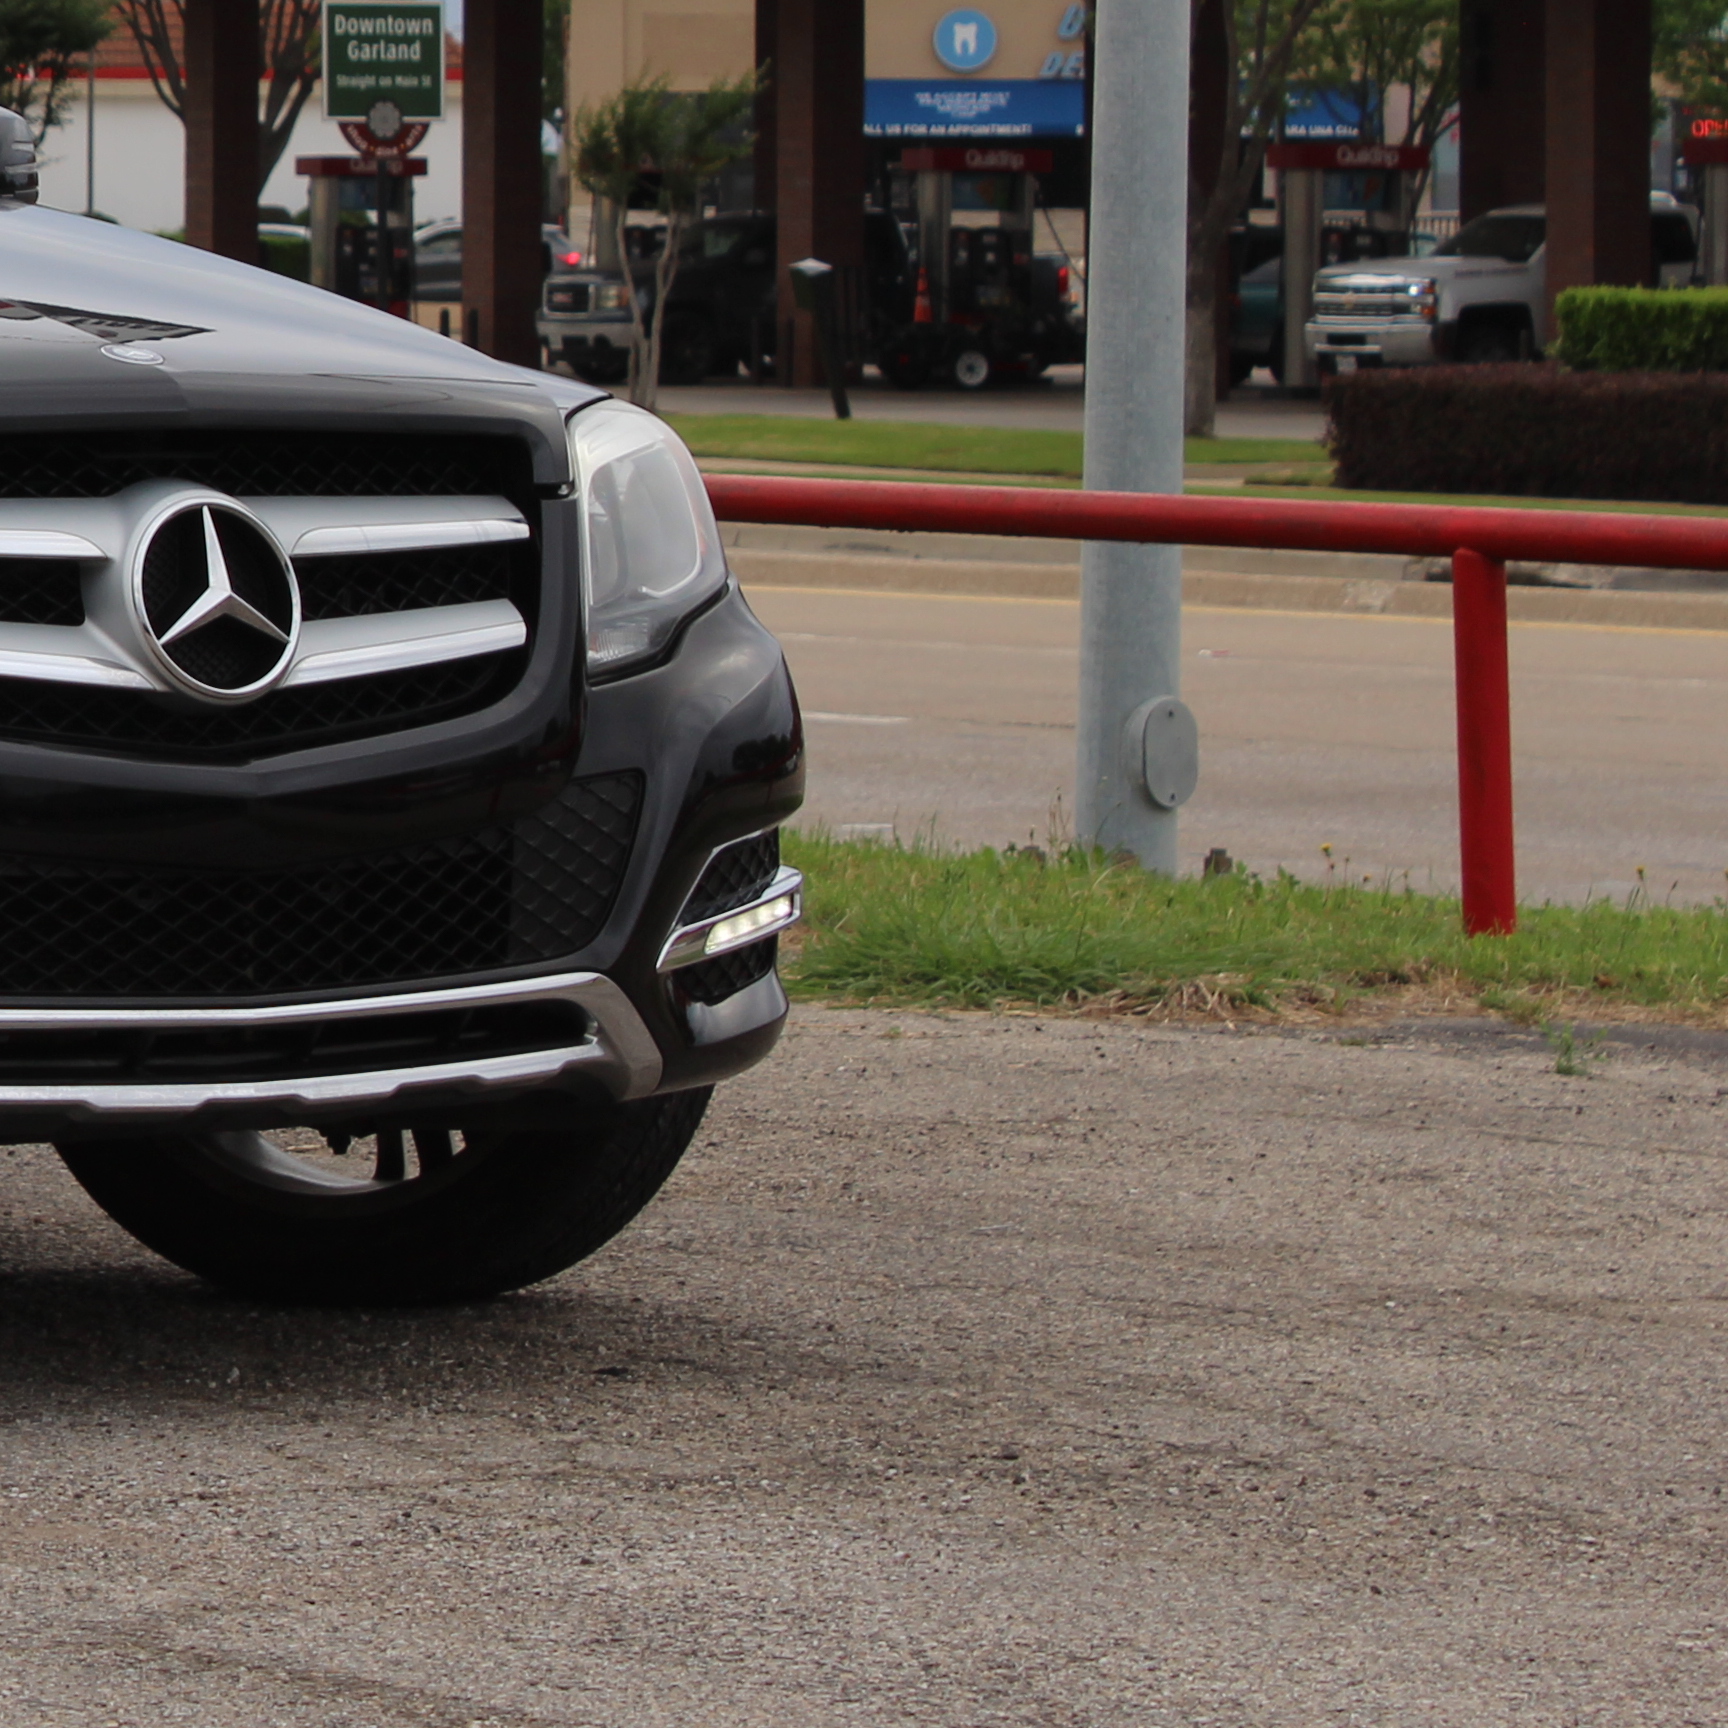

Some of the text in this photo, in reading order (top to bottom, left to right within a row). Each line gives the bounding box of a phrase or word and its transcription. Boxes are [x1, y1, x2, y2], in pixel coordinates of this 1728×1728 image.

[334, 13, 433, 35] Downtown
[347, 39, 421, 61] Garland
[336, 74, 432, 90] Straight on Main St
[863, 124, 883, 136] ALL
[904, 124, 928, 136] FOR
[929, 124, 946, 136] AN
